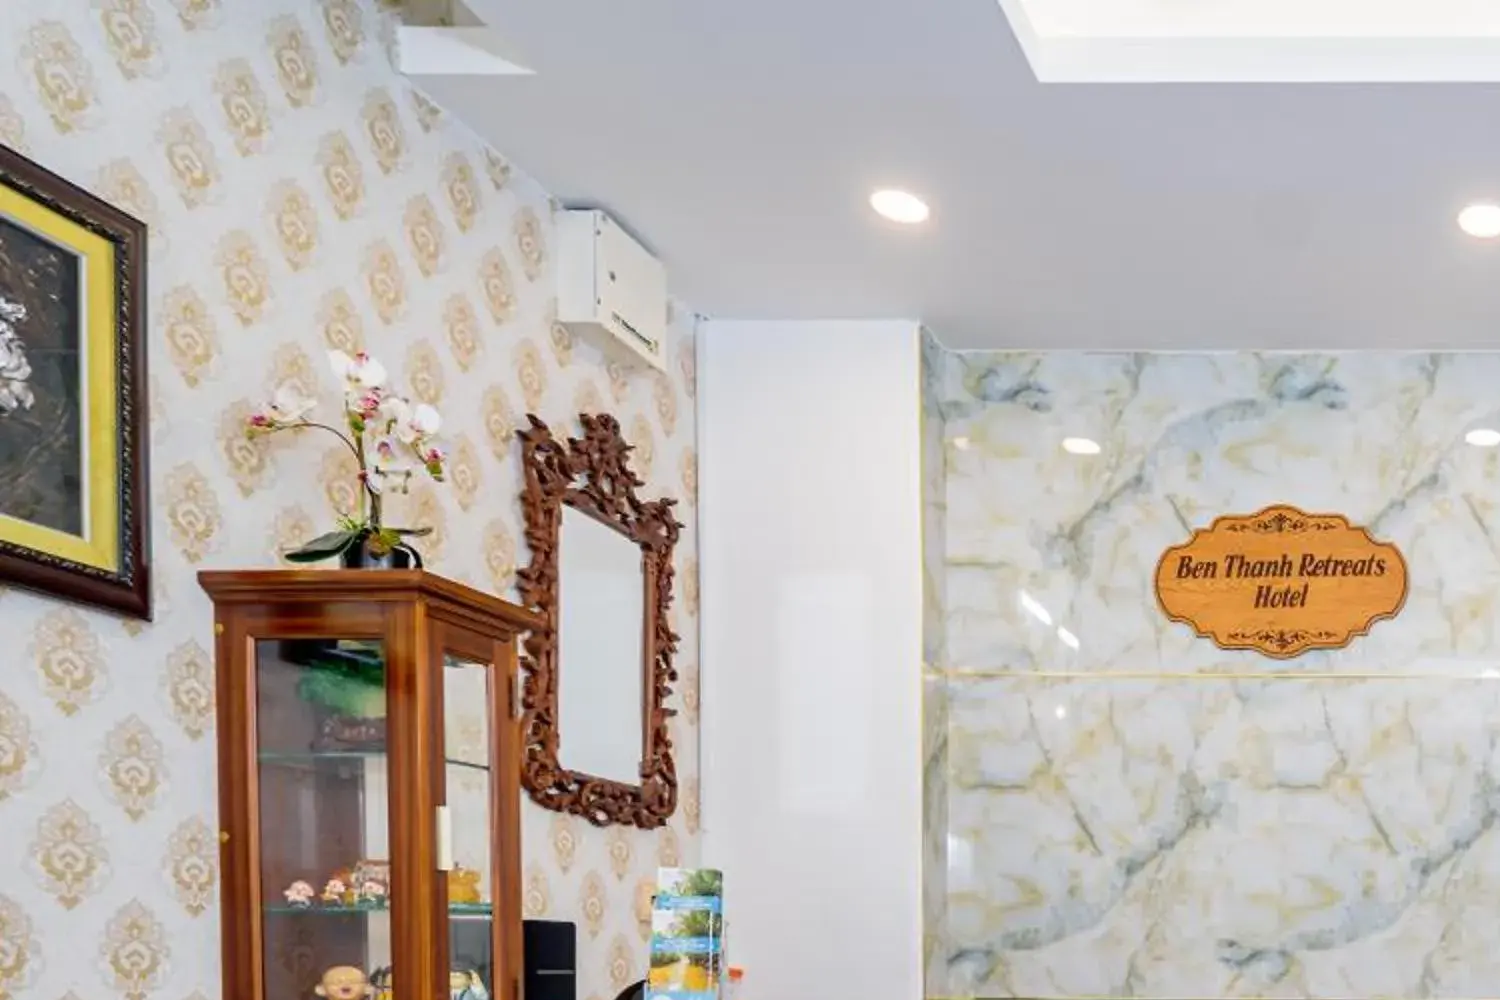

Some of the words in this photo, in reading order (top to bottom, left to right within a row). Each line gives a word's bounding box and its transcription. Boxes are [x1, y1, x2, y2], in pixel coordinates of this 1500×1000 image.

[1176, 555, 1217, 579] Ben
[1224, 554, 1293, 579] Thanh
[1299, 553, 1386, 577] Retreats
[1254, 583, 1309, 608] Hotel
